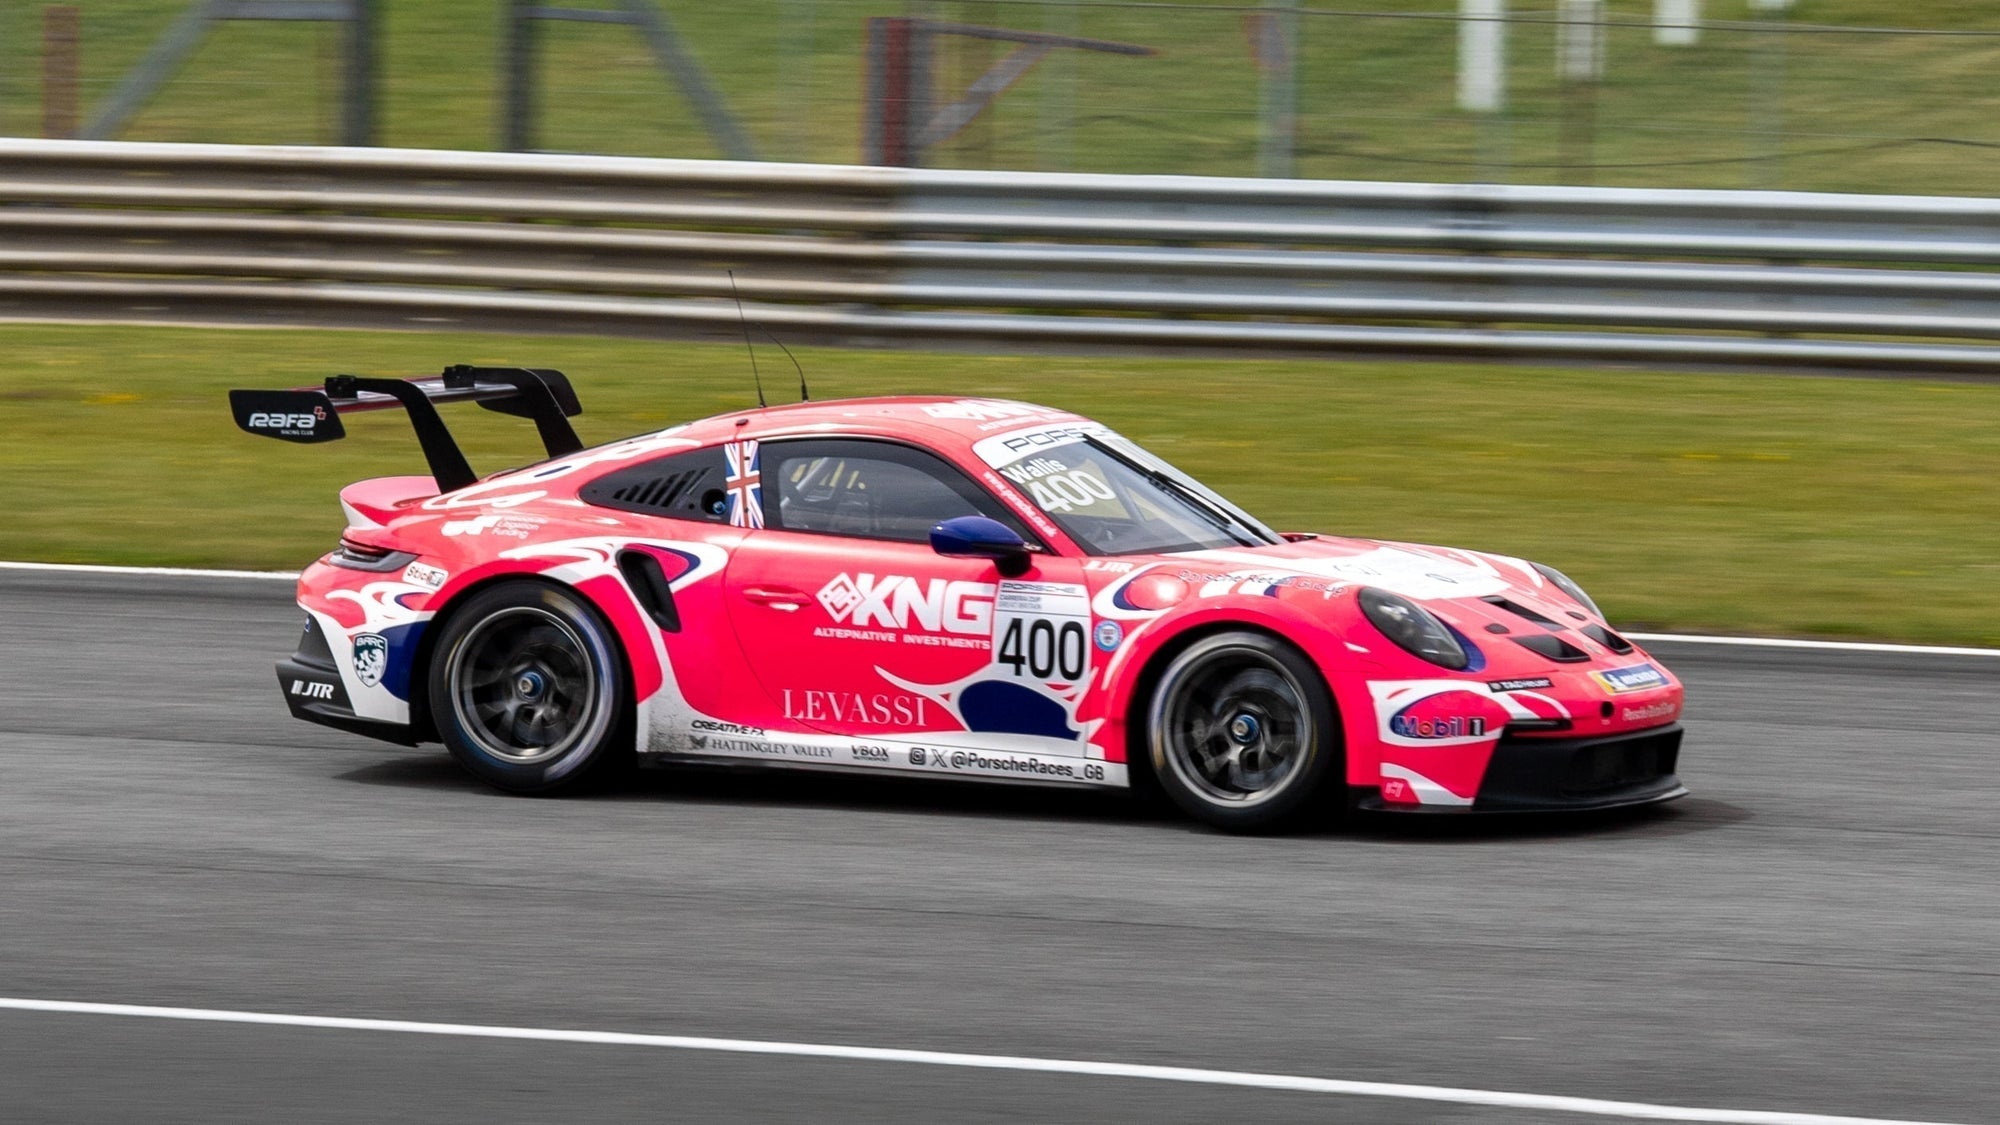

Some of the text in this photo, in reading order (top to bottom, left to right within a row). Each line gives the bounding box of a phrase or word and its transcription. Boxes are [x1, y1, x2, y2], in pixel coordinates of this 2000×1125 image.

[1000, 458, 1068, 484] Wallis
[1029, 470, 1117, 512] 400
[1001, 583, 1076, 594] PORSCHE
[852, 572, 997, 636] KNG
[356, 637, 385, 649] BARC
[813, 627, 991, 650] ALTERNATIVE INVESTMENTS
[998, 617, 1085, 681] 400
[301, 681, 334, 699] JTR
[782, 689, 927, 727] LEVASSI
[691, 719, 765, 736] CREATIVE FX
[1394, 716, 1464, 737] Mobil
[711, 739, 834, 758] HATTINGLEY VALLEY
[851, 745, 889, 758] VBOX
[951, 751, 1104, 780] @PorscheRaces_GB
